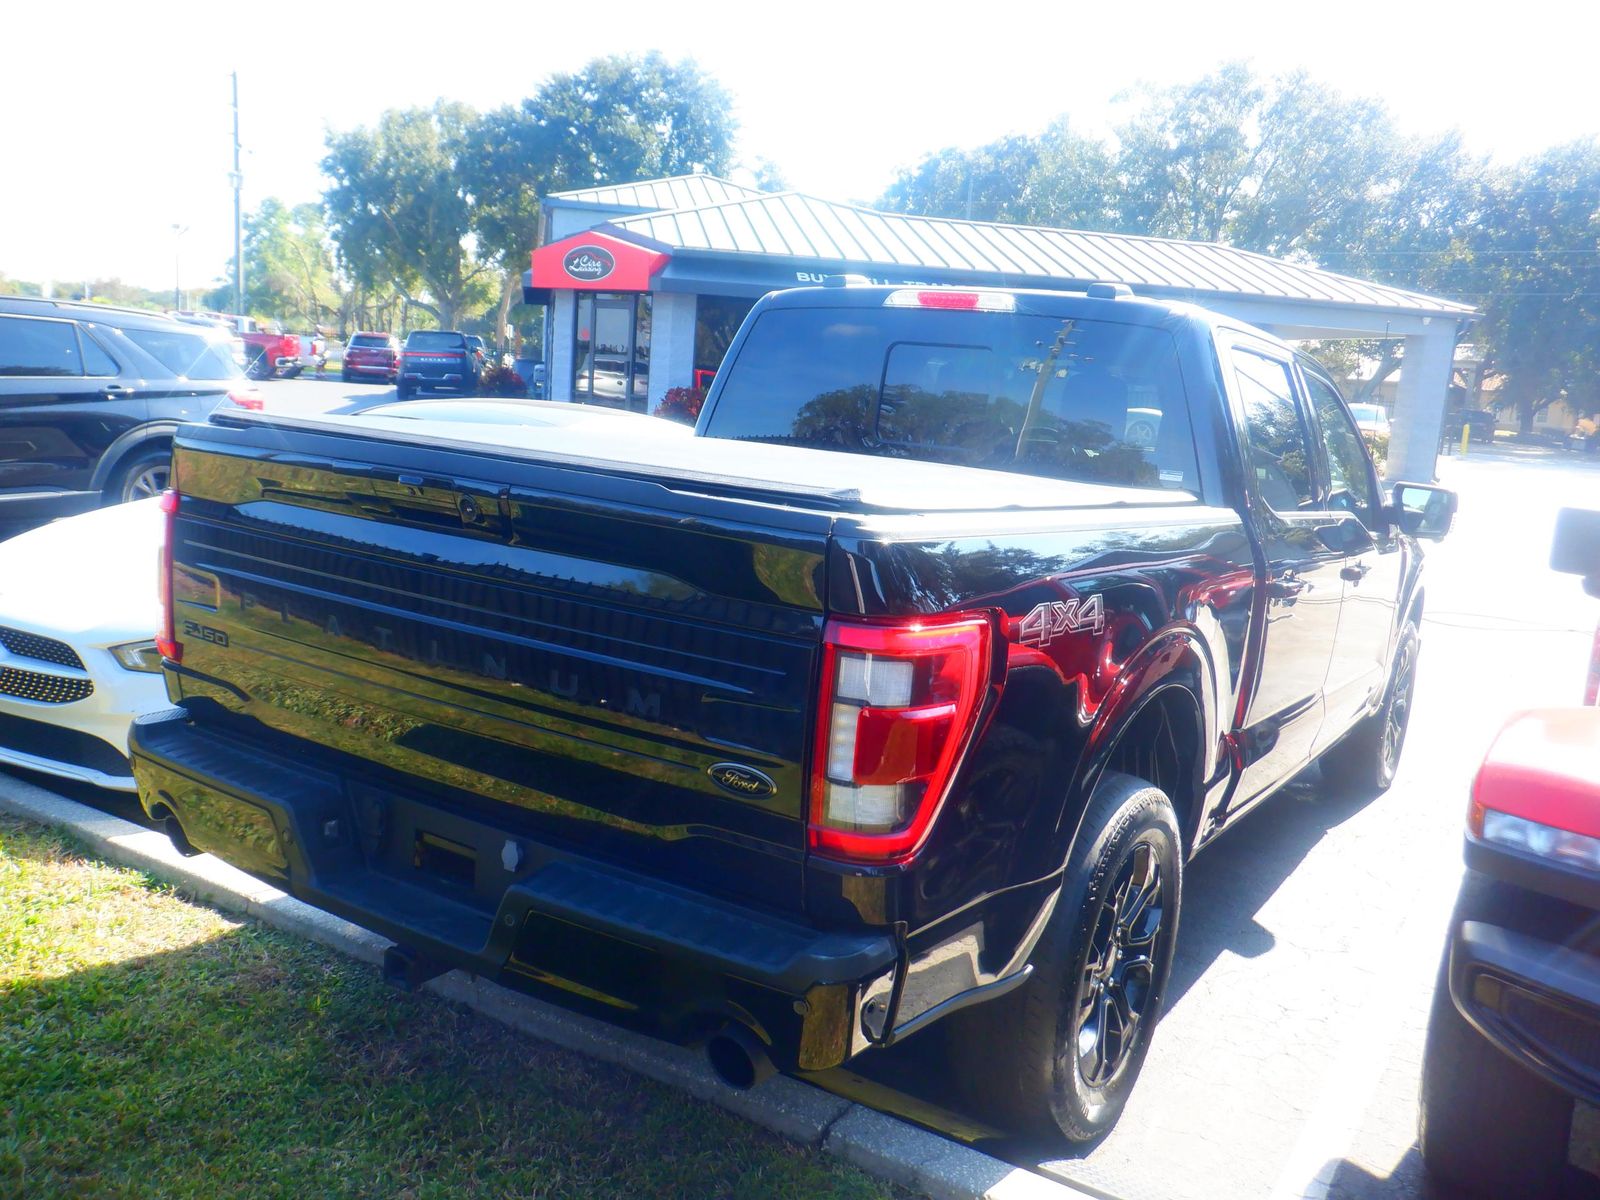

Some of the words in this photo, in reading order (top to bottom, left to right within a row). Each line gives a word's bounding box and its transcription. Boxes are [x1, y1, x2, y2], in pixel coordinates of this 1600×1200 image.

[796, 272, 828, 284] BU
[240, 592, 661, 719] PLATINUM
[721, 769, 759, 792] Ford
